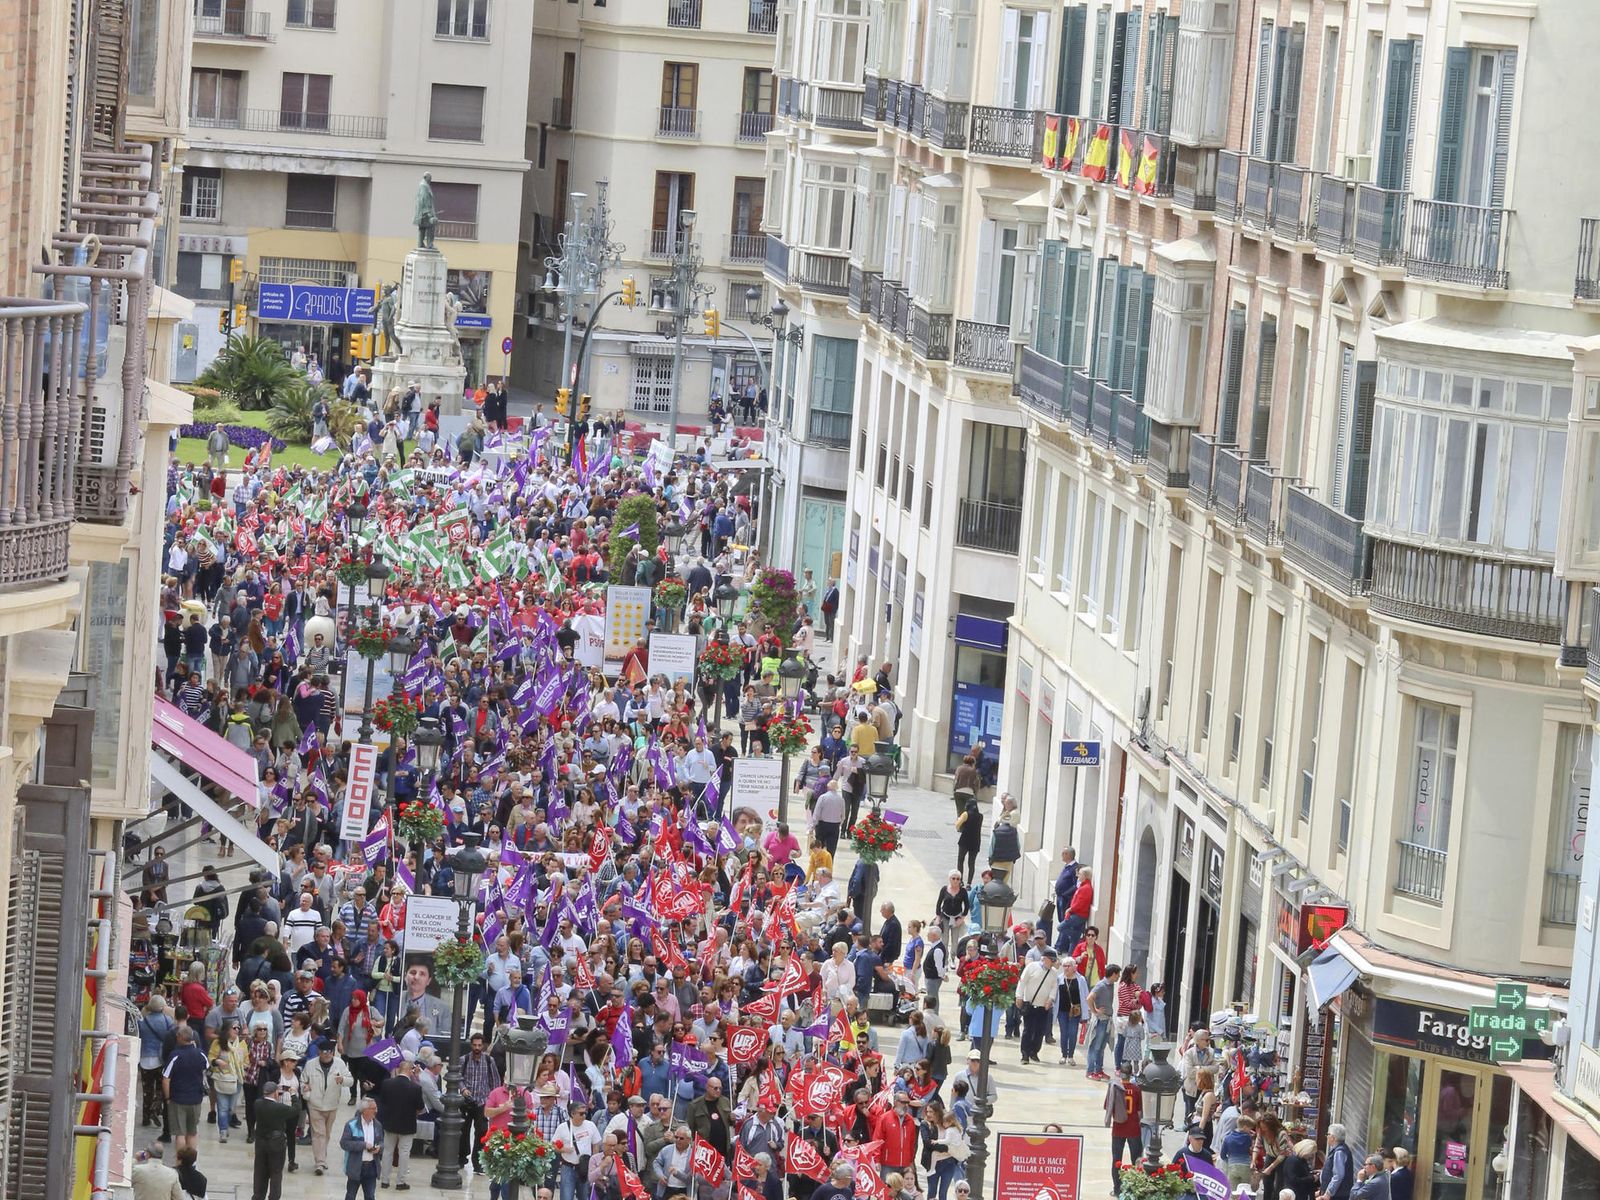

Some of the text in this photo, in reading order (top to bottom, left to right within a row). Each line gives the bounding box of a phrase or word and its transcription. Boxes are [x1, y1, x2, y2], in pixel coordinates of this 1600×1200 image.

[1062, 755, 1098, 765] TELEBANCO
[348, 747, 373, 819] CCOO
[1012, 1155, 1067, 1165] BRILLAR ES HACER
[1012, 1165, 1038, 1173] BRILLAR
[1045, 1166, 1065, 1174] OTROS
